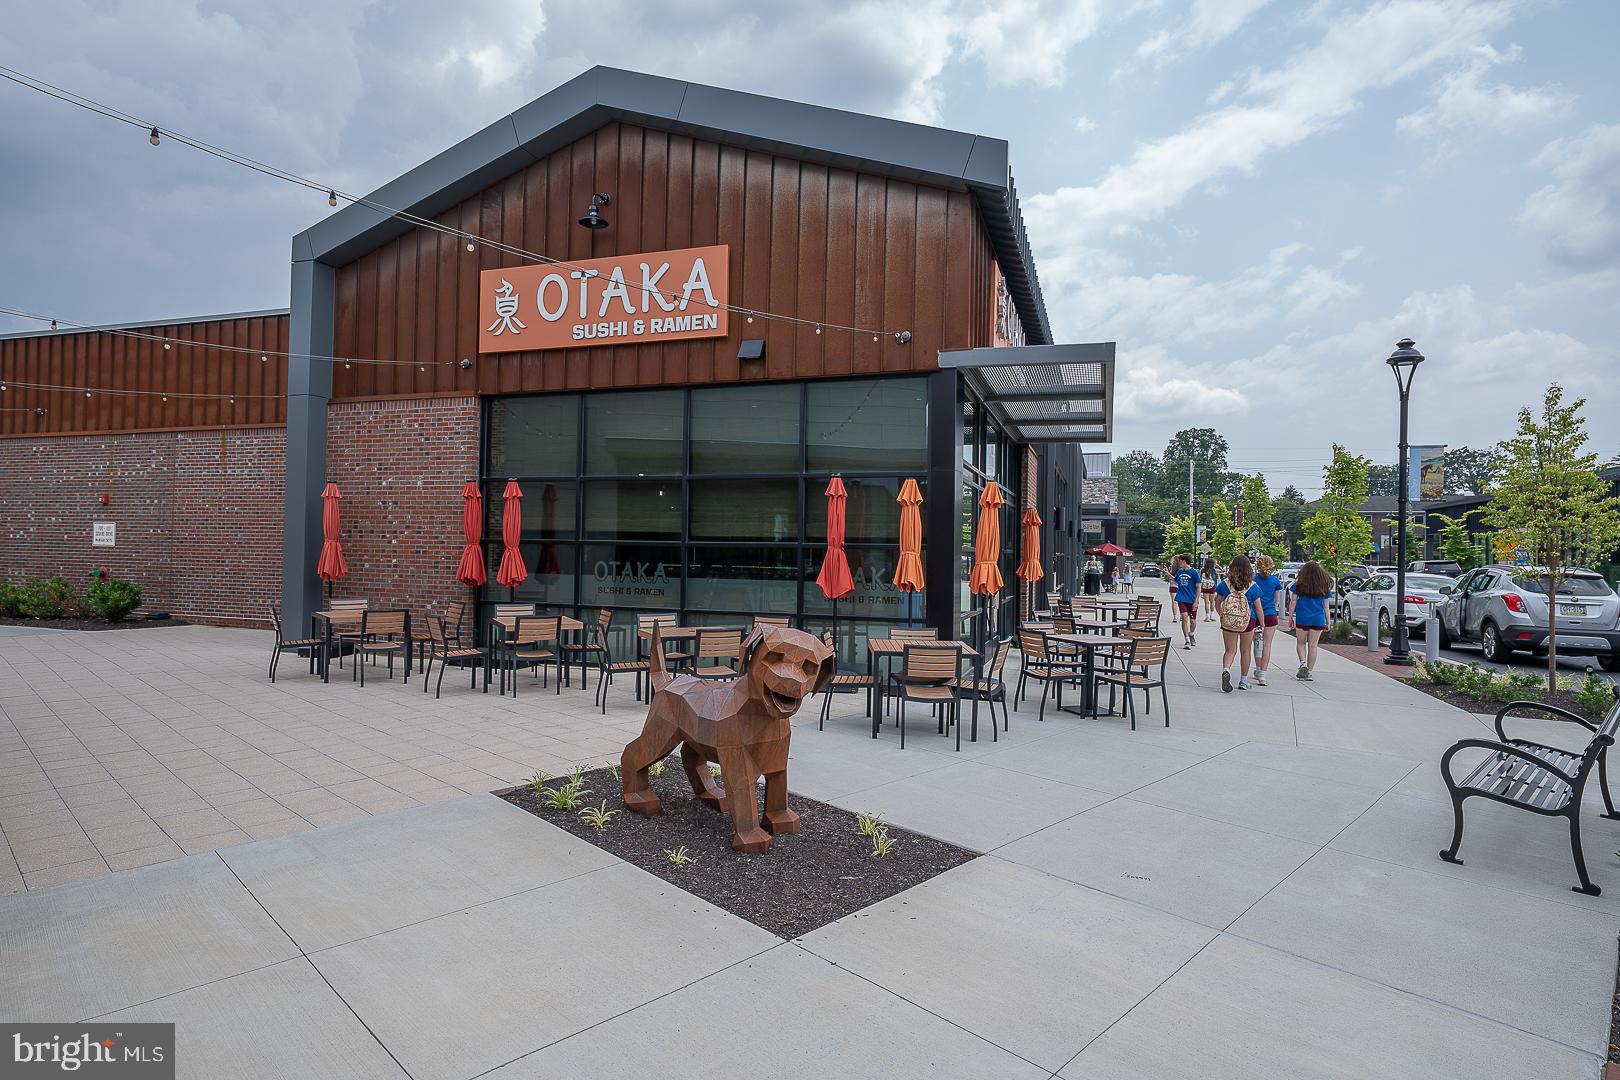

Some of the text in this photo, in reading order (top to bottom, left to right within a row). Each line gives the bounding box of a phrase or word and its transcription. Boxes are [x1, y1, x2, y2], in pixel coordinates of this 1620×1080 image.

[536, 257, 720, 322] OTAKA
[572, 313, 718, 340] SUSHI & RAMEN
[594, 560, 670, 584] OTAKA
[597, 586, 624, 595] SUSHI
[634, 587, 665, 597] RAMEN
[867, 595, 905, 605] RAMEN
